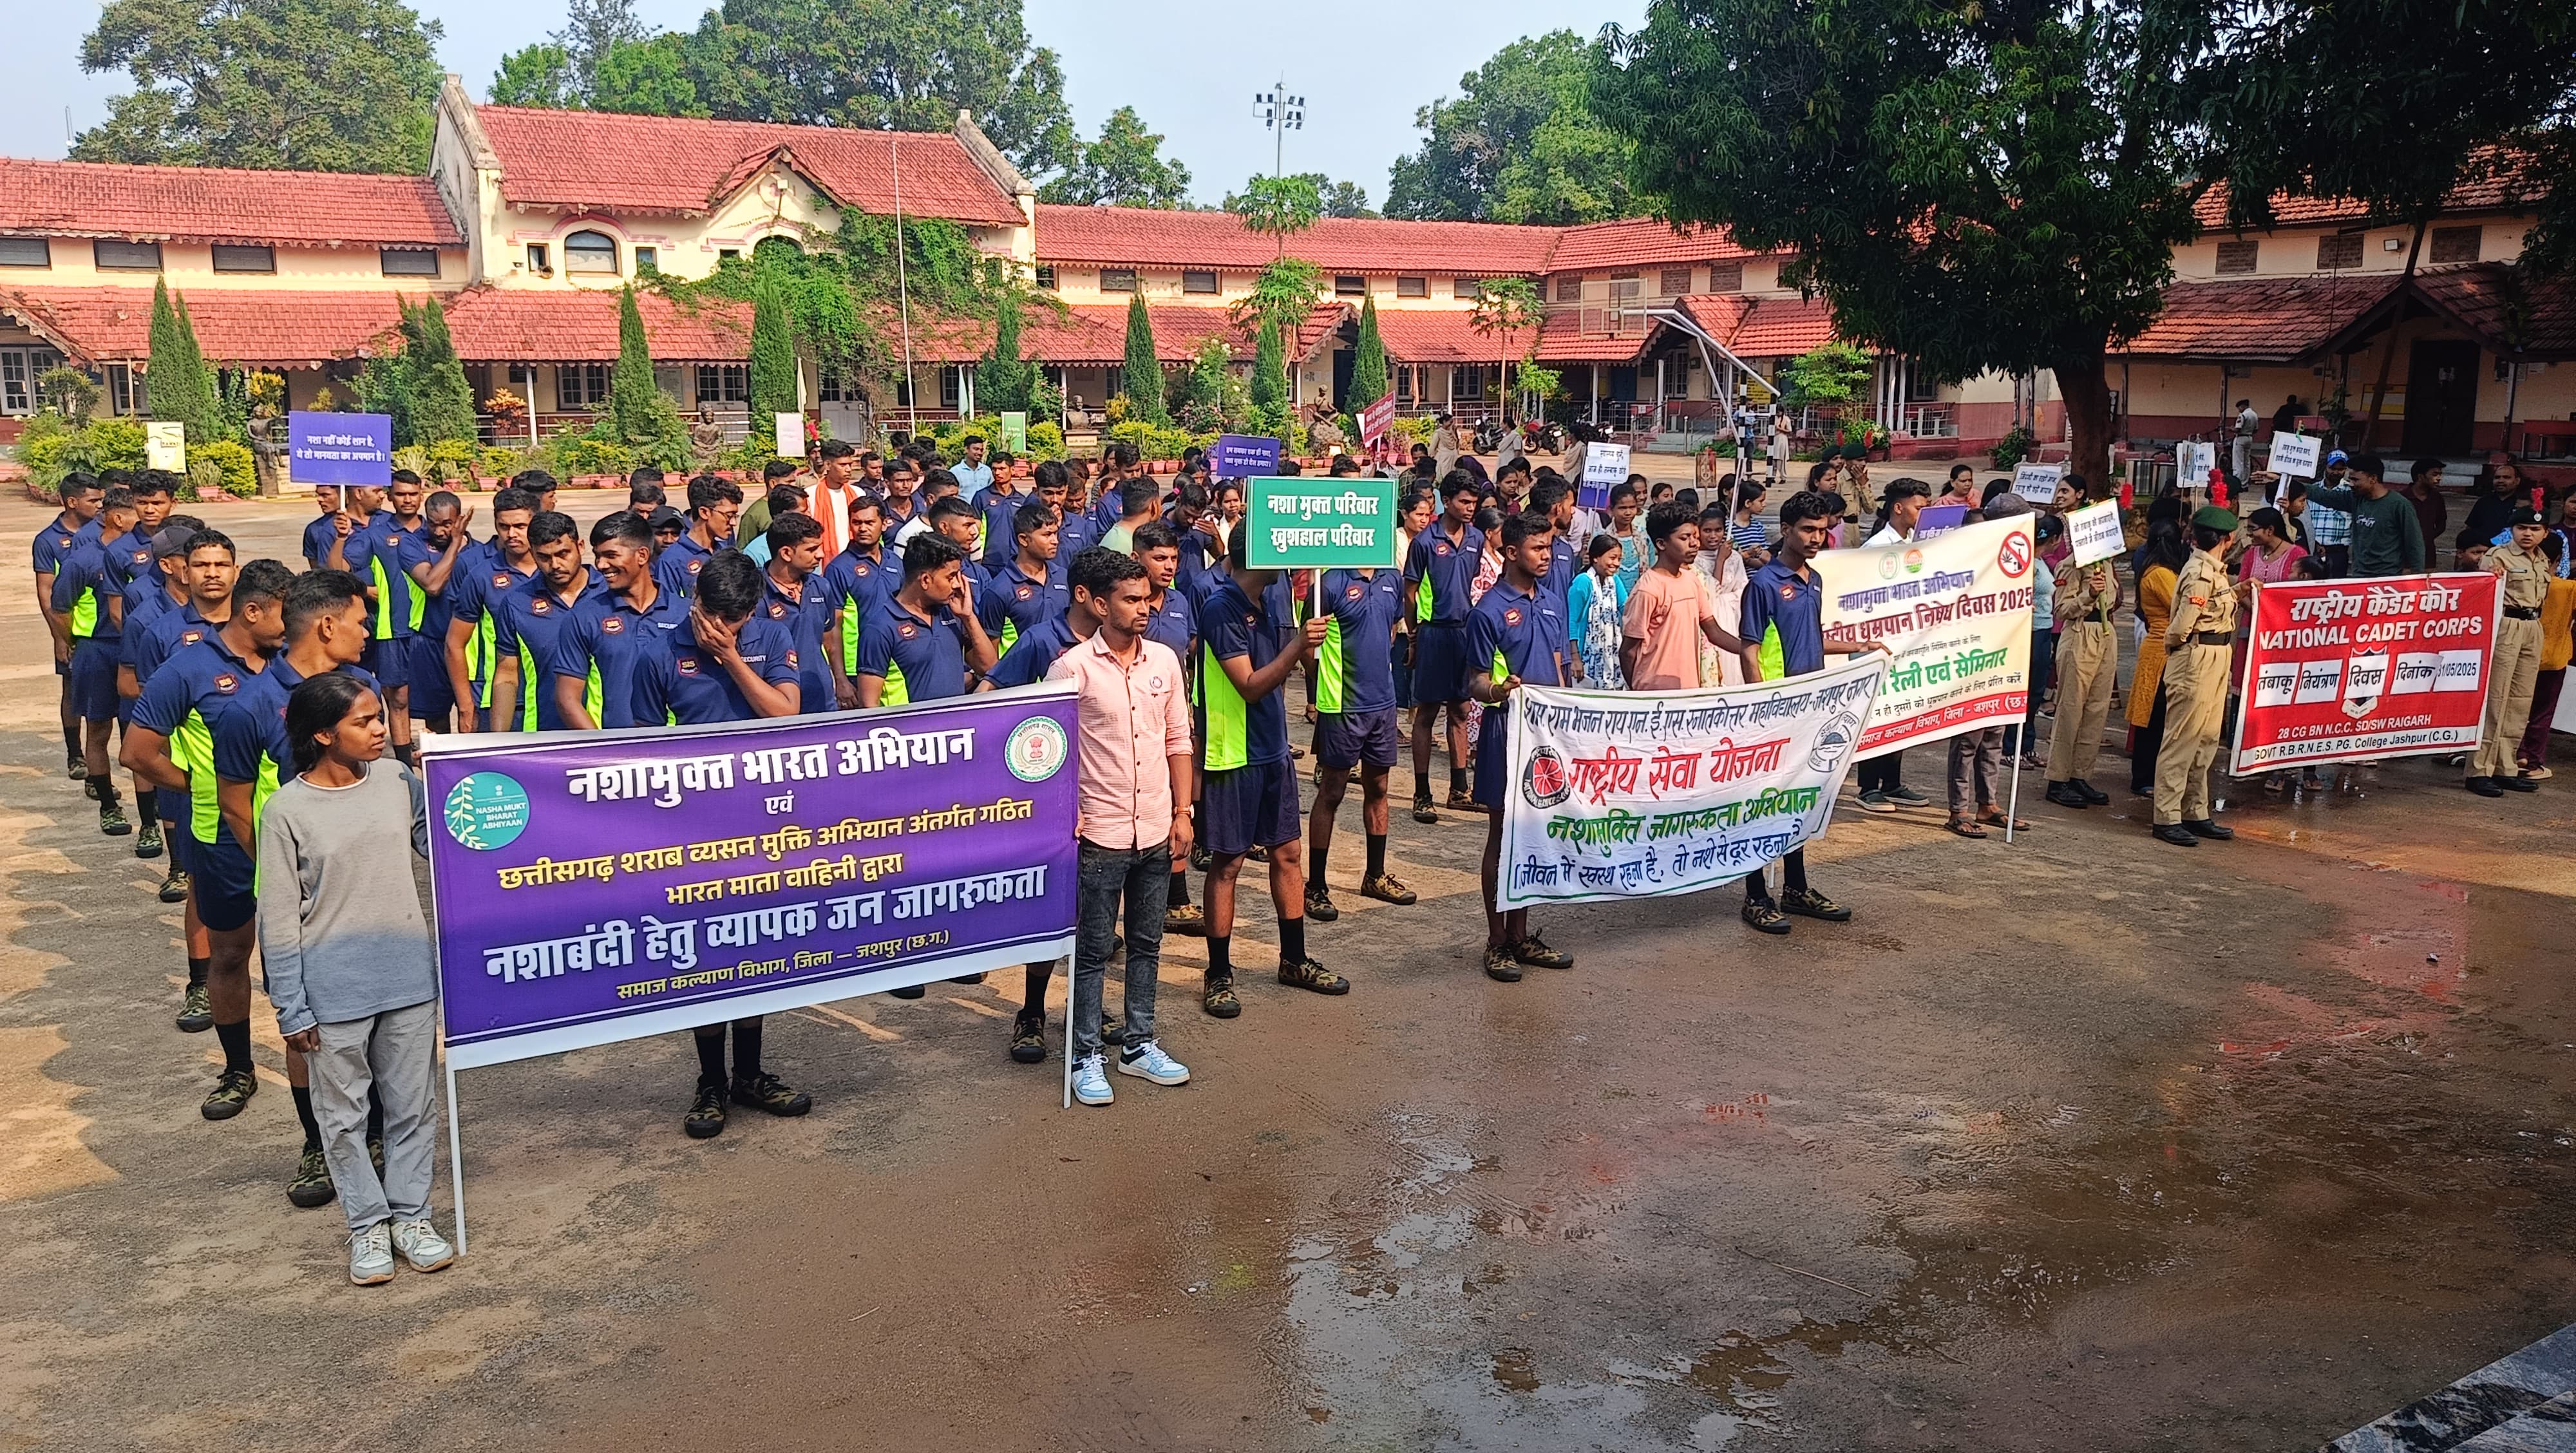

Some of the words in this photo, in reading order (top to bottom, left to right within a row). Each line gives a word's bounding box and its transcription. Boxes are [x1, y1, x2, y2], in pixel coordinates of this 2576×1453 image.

[1267, 495, 1298, 514] नशा
[1300, 495, 1332, 520] मुक्त
[1334, 491, 1379, 515] परिवार
[1270, 527, 1329, 553] खुशहाल
[1330, 523, 1376, 547] परिवार
[1914, 601, 1955, 629] निषेध
[1956, 593, 1996, 620] दिवस
[2000, 586, 2033, 613] 2025
[2290, 590, 2364, 625] राष्ट्रीय
[2366, 586, 2417, 616] कैडेट
[2418, 582, 2462, 612] कोर
[2259, 625, 2349, 651] NATIONAL
[2355, 620, 2420, 643] CADET
[2423, 616, 2482, 638] CORPS
[1889, 661, 1922, 692] रैली
[1925, 656, 1951, 684] एवं
[1953, 647, 2008, 677] सेमिनार
[2258, 670, 2295, 695] तंबाकू
[2299, 667, 2340, 691] नियंत्रण
[2349, 665, 2385, 687] दिवस
[2396, 660, 2436, 681] दिनांक
[2437, 662, 2477, 678] 31/05/2025
[1884, 723, 1913, 739] कल्याण
[1943, 707, 1965, 723] जिला
[1973, 700, 2001, 716] जशपुर
[1914, 696, 1924, 708] को
[1548, 705, 1573, 737] राम
[1572, 705, 1605, 733] भजन
[1605, 710, 1628, 740] राय
[2278, 727, 2289, 740] 28
[2292, 725, 2307, 739] CG
[2309, 724, 2323, 737] BN
[2325, 721, 2353, 735] N.C.C.
[2356, 717, 2388, 733] SD/SW
[2387, 714, 2432, 729] RAIGARH
[2255, 747, 2277, 761] GOVT
[2279, 741, 2334, 757] R.B.R.N.E.S.
[2336, 738, 2352, 750] PG.
[2355, 734, 2387, 749] College
[2390, 732, 2427, 746] Jashpur
[2429, 729, 2458, 743] (C.G.)
[565, 752, 735, 808] नशामुक्त
[741, 743, 829, 784] भारत
[835, 726, 976, 777] अभियान
[1569, 746, 1642, 806] राष्ट्रीय
[1649, 746, 1701, 801] सेवा
[1710, 737, 1791, 783] योजना
[476, 805, 503, 814] NASHA
[504, 802, 526, 811] MUKT
[486, 812, 518, 821] BHARAT
[764, 790, 795, 815] एवं
[482, 819, 523, 830] ABHIYAAN
[1547, 808, 1647, 858] नशामुक्ति
[1743, 786, 1821, 824] अभियान
[497, 855, 615, 890] छत्तीसगढ़
[620, 845, 684, 874] शराब
[687, 835, 757, 862] व्यसन
[760, 824, 812, 862] मुक्ति
[816, 817, 904, 847] अभियान
[907, 804, 978, 834] अंतर्गत
[978, 796, 1034, 824] गठित
[665, 878, 724, 906] भारत
[728, 870, 780, 897] माता
[783, 853, 857, 888] वाहिनी
[860, 853, 904, 883] द्वारा
[1560, 855, 1576, 882] में
[1578, 866, 1616, 888] स्वस्थ
[1619, 860, 1643, 891] रहना
[1672, 844, 1690, 877] तो
[1692, 838, 1717, 869] नशे
[1716, 835, 1731, 866] से
[1729, 838, 1750, 866] दूर
[484, 920, 636, 983] नशाबंदी
[640, 915, 698, 970] हेतु
[703, 901, 819, 949] व्यापक
[825, 890, 886, 931] जन
[616, 978, 667, 999] समाज
[669, 967, 735, 991] कल्याण
[737, 958, 791, 980] विभाग,
[793, 947, 833, 971] जिला
[855, 939, 903, 960] जशपुर
[905, 929, 951, 951] (छ.ग.)
